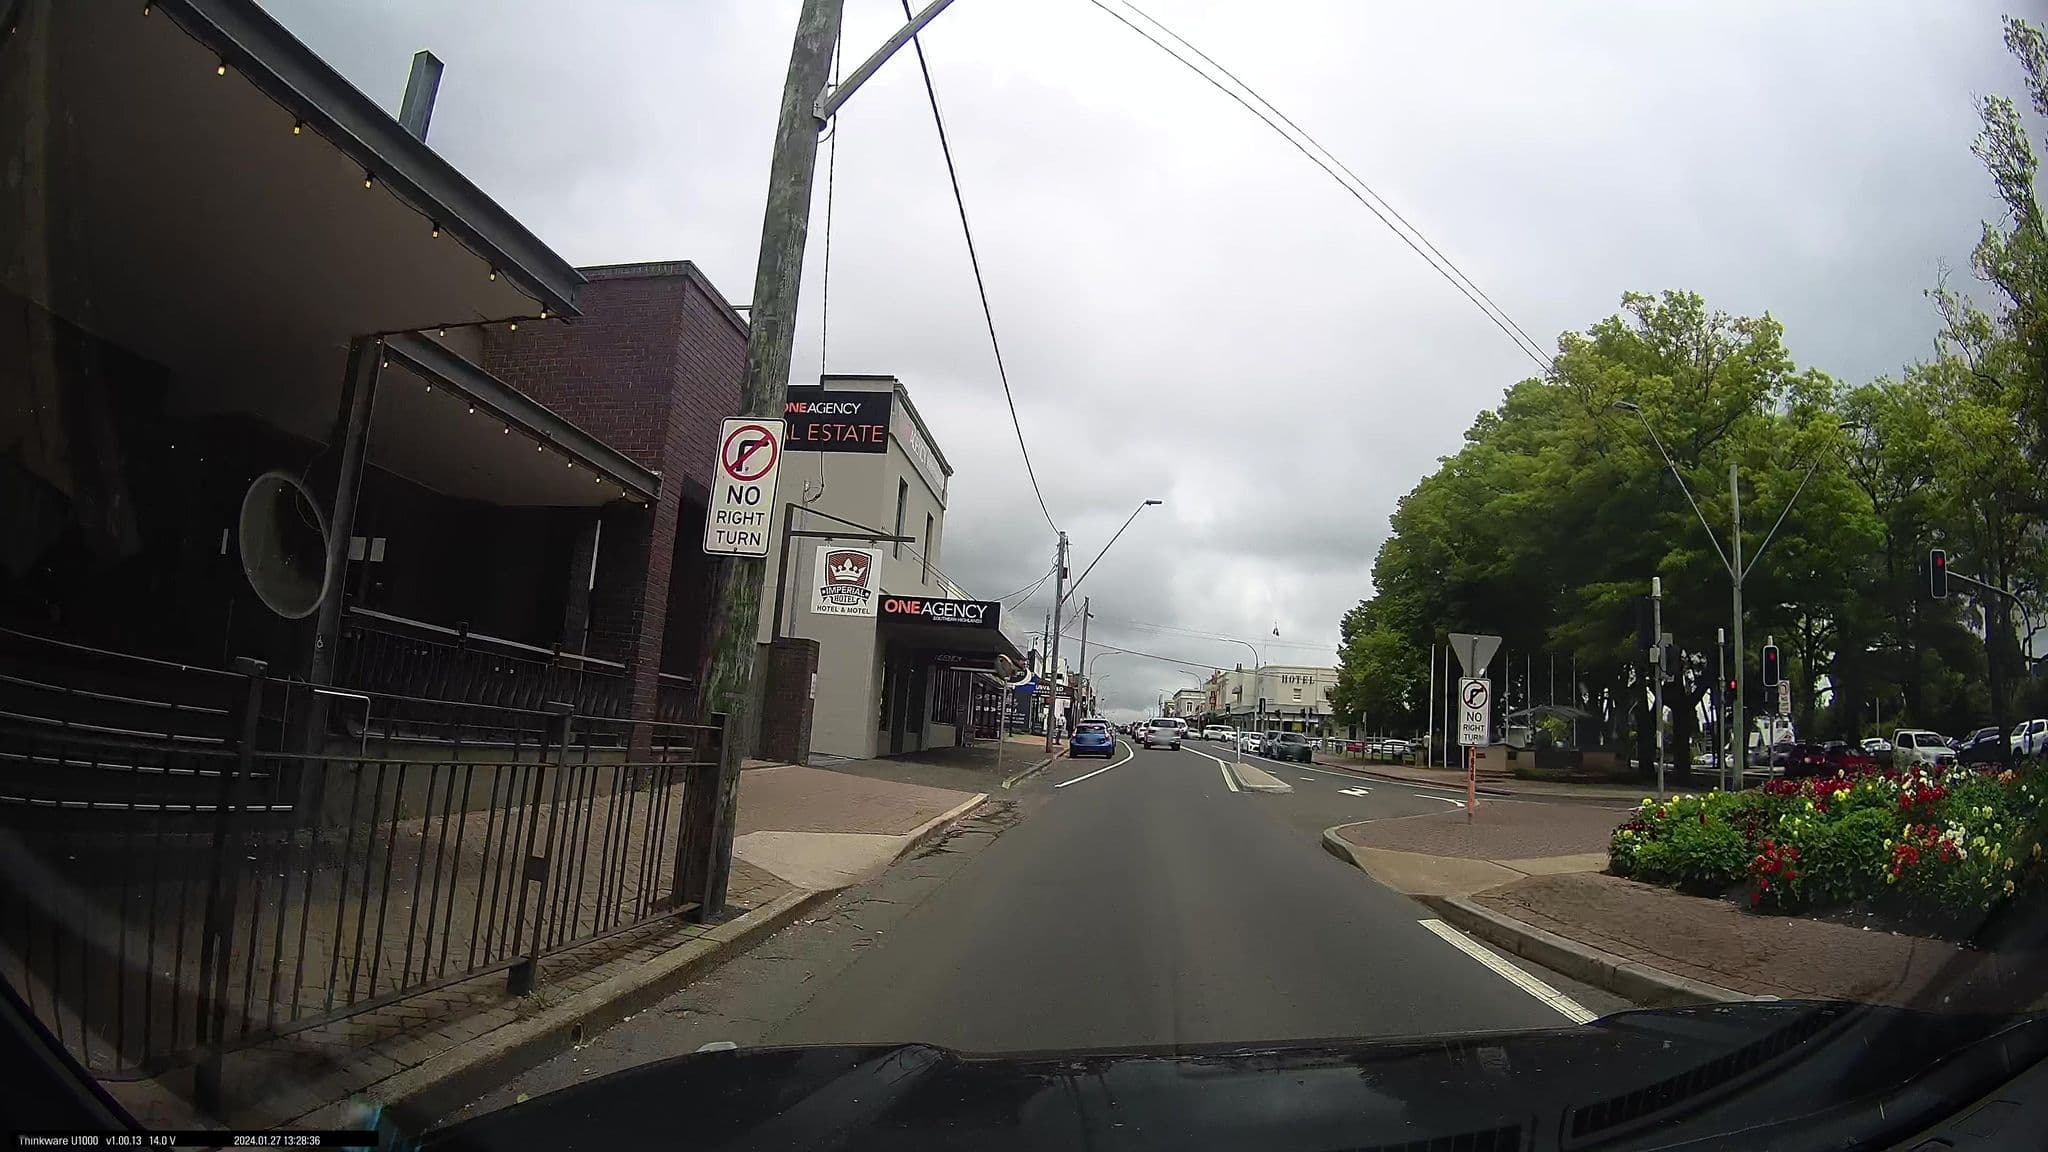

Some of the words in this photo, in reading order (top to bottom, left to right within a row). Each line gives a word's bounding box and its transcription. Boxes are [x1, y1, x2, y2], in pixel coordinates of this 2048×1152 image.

[807, 423, 884, 443] ESTATE
[727, 485, 761, 506] NO
[716, 510, 765, 526] RIGHT
[716, 530, 761, 546] TURN
[825, 585, 865, 598] IMPERIAL
[833, 595, 856, 603] HOTEL
[816, 604, 837, 613] HOTEL
[847, 606, 871, 615] MOTEL
[884, 598, 988, 619] ONEAGENCY
[1281, 674, 1315, 685] HOTEL
[1466, 712, 1482, 722] NO
[1463, 723, 1485, 732] RIGHT
[1463, 733, 1484, 741] TURN
